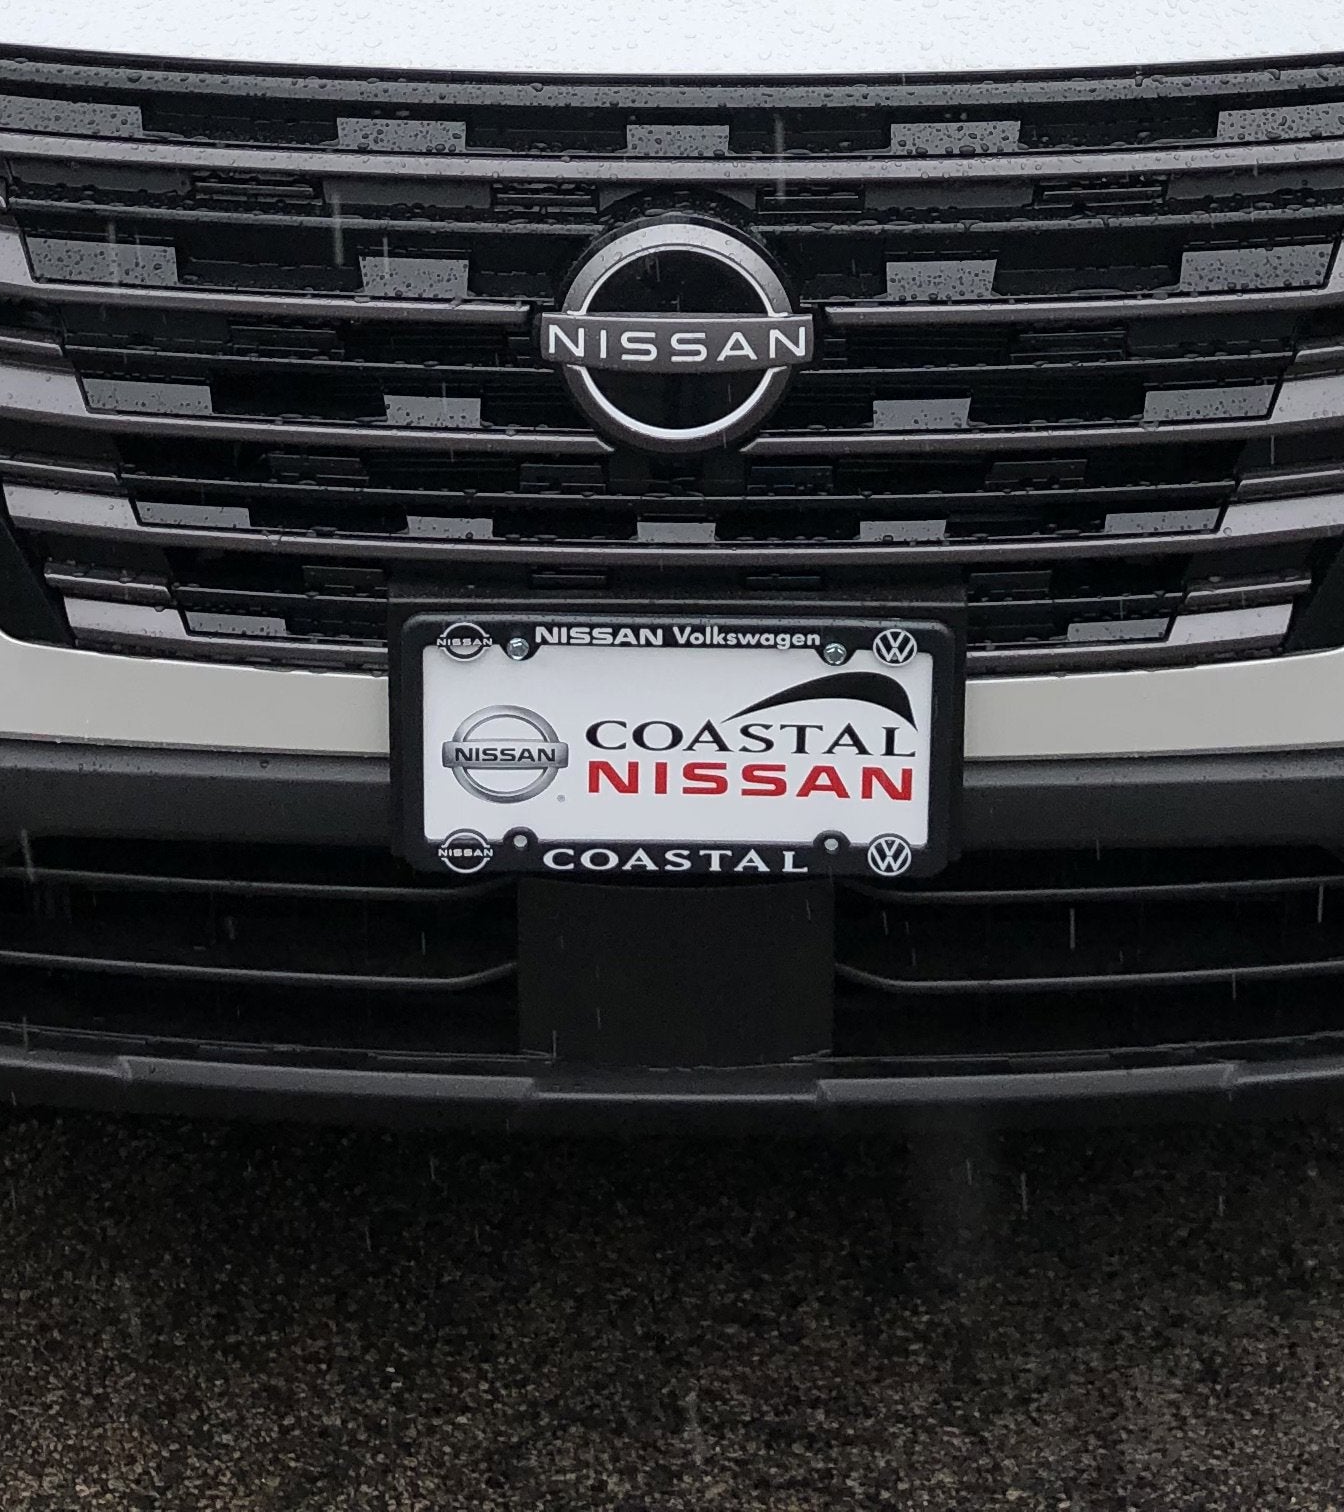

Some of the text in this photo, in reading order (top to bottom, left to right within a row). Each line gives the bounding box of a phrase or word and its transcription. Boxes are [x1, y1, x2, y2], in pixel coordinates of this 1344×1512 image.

[548, 324, 806, 363] NISSAN
[436, 637, 493, 647] NISSAN
[534, 625, 821, 650] NISSAN Volkswagen
[585, 718, 917, 758] COASTAL
[455, 746, 556, 764] NISSAN
[588, 760, 913, 801] NISSAN
[438, 848, 494, 858] NISSAN
[543, 848, 808, 873] COASTAL
